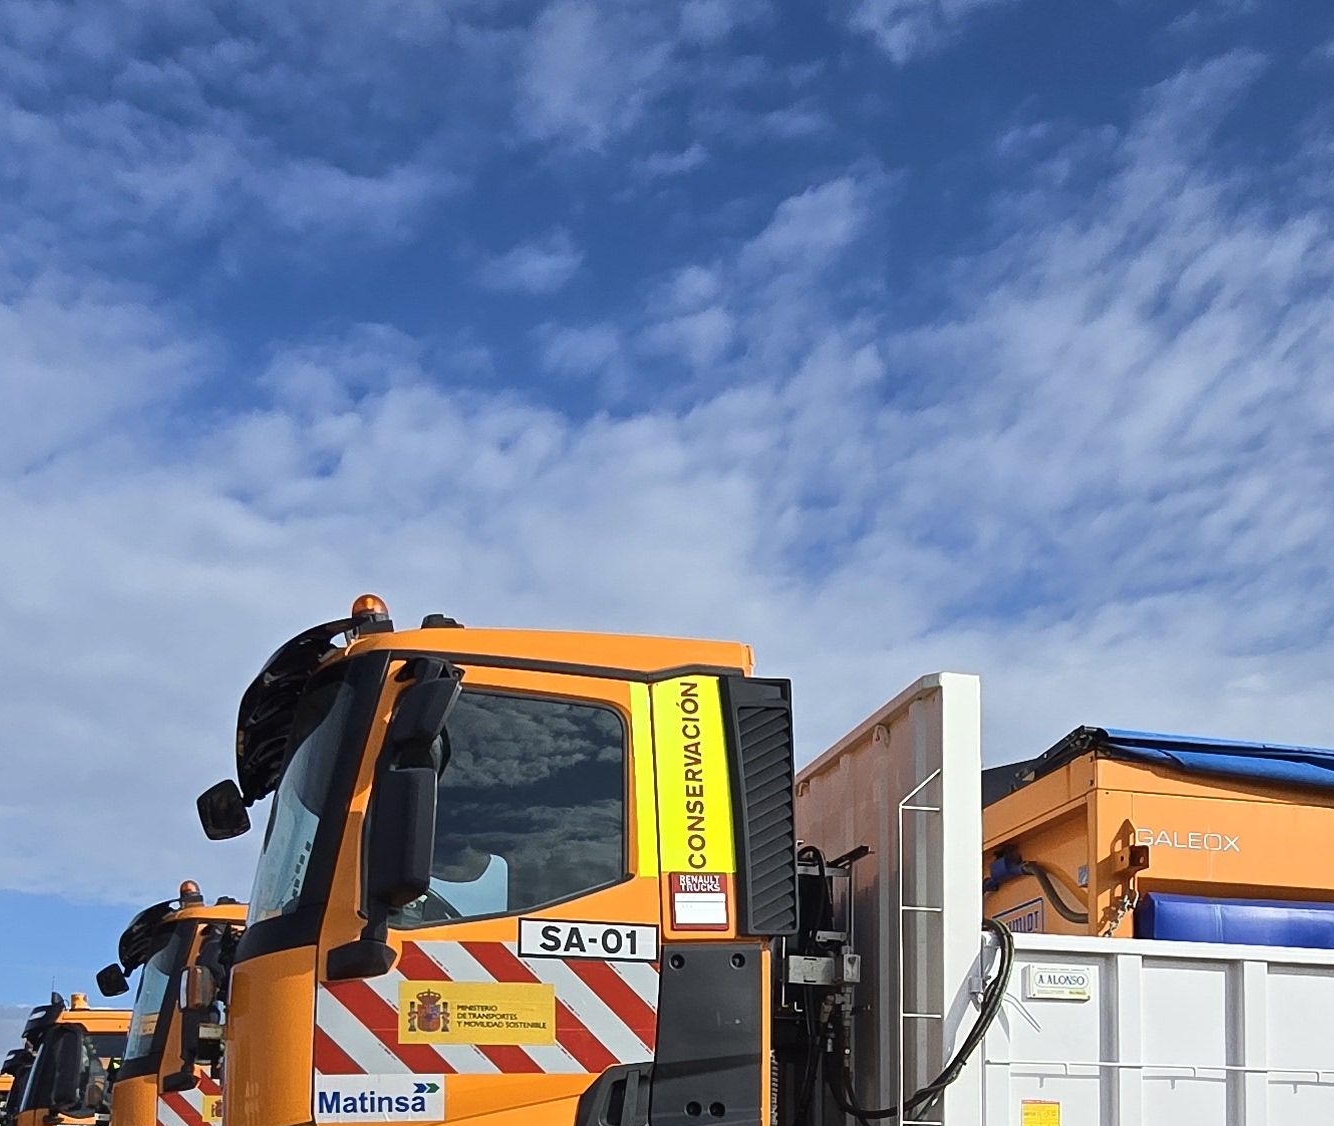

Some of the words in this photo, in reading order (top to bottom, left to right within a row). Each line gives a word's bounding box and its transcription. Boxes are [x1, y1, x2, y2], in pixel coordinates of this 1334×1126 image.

[675, 681, 707, 869] CONSERVACIÓN
[679, 874, 721, 885] RENAULT
[680, 883, 721, 892] TRUCKS
[539, 925, 637, 955] SA-01
[1047, 974, 1086, 986] ALONSO
[456, 1004, 498, 1012] MINISTERIO
[456, 1012, 468, 1020] DE
[468, 1012, 518, 1021] TRANSPORTES
[456, 1020, 462, 1028] Y
[463, 1020, 504, 1029] MOVILIDAD
[505, 1021, 547, 1030] SOSTENIBLE
[318, 1090, 426, 1114] Matinsa
